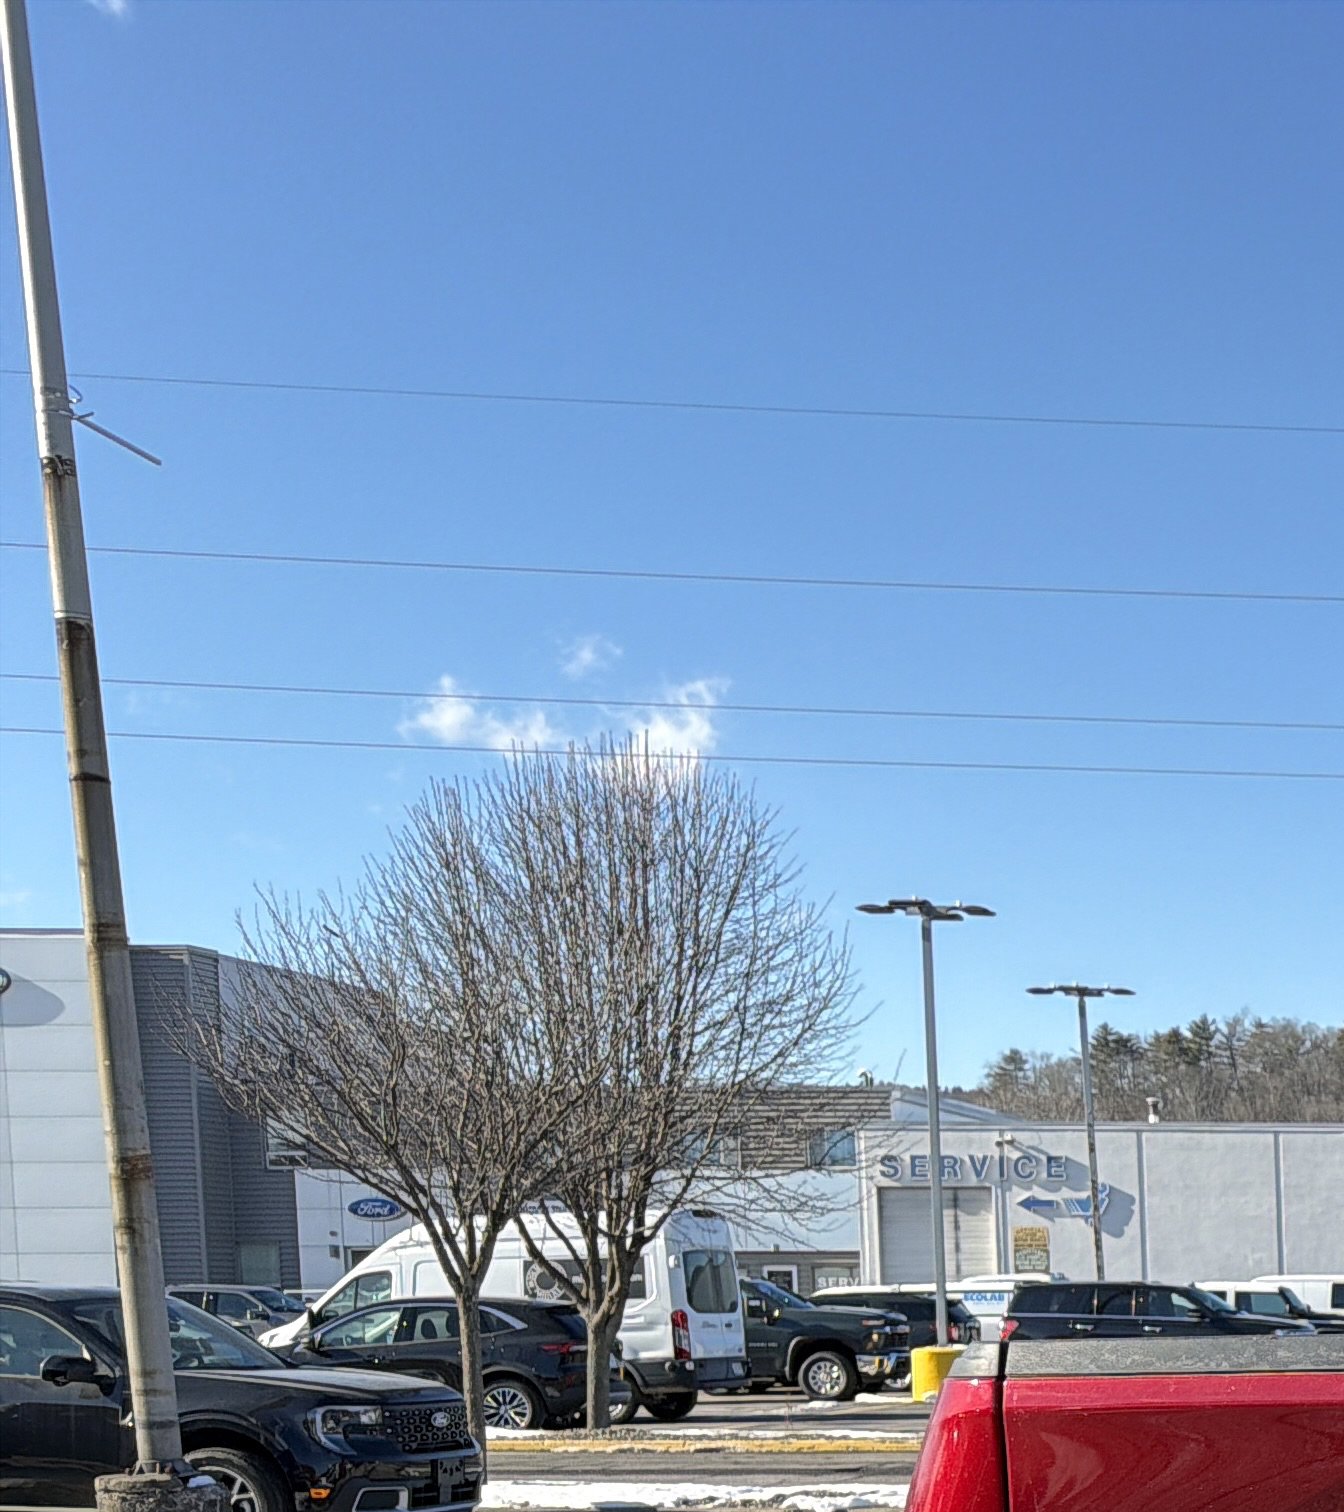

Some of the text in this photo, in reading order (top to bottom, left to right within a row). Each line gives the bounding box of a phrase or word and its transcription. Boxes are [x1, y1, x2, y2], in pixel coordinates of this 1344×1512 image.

[879, 1154, 1067, 1181] SERVICE
[357, 1201, 390, 1215] Ford
[963, 1291, 1005, 1302] ECOLAB
